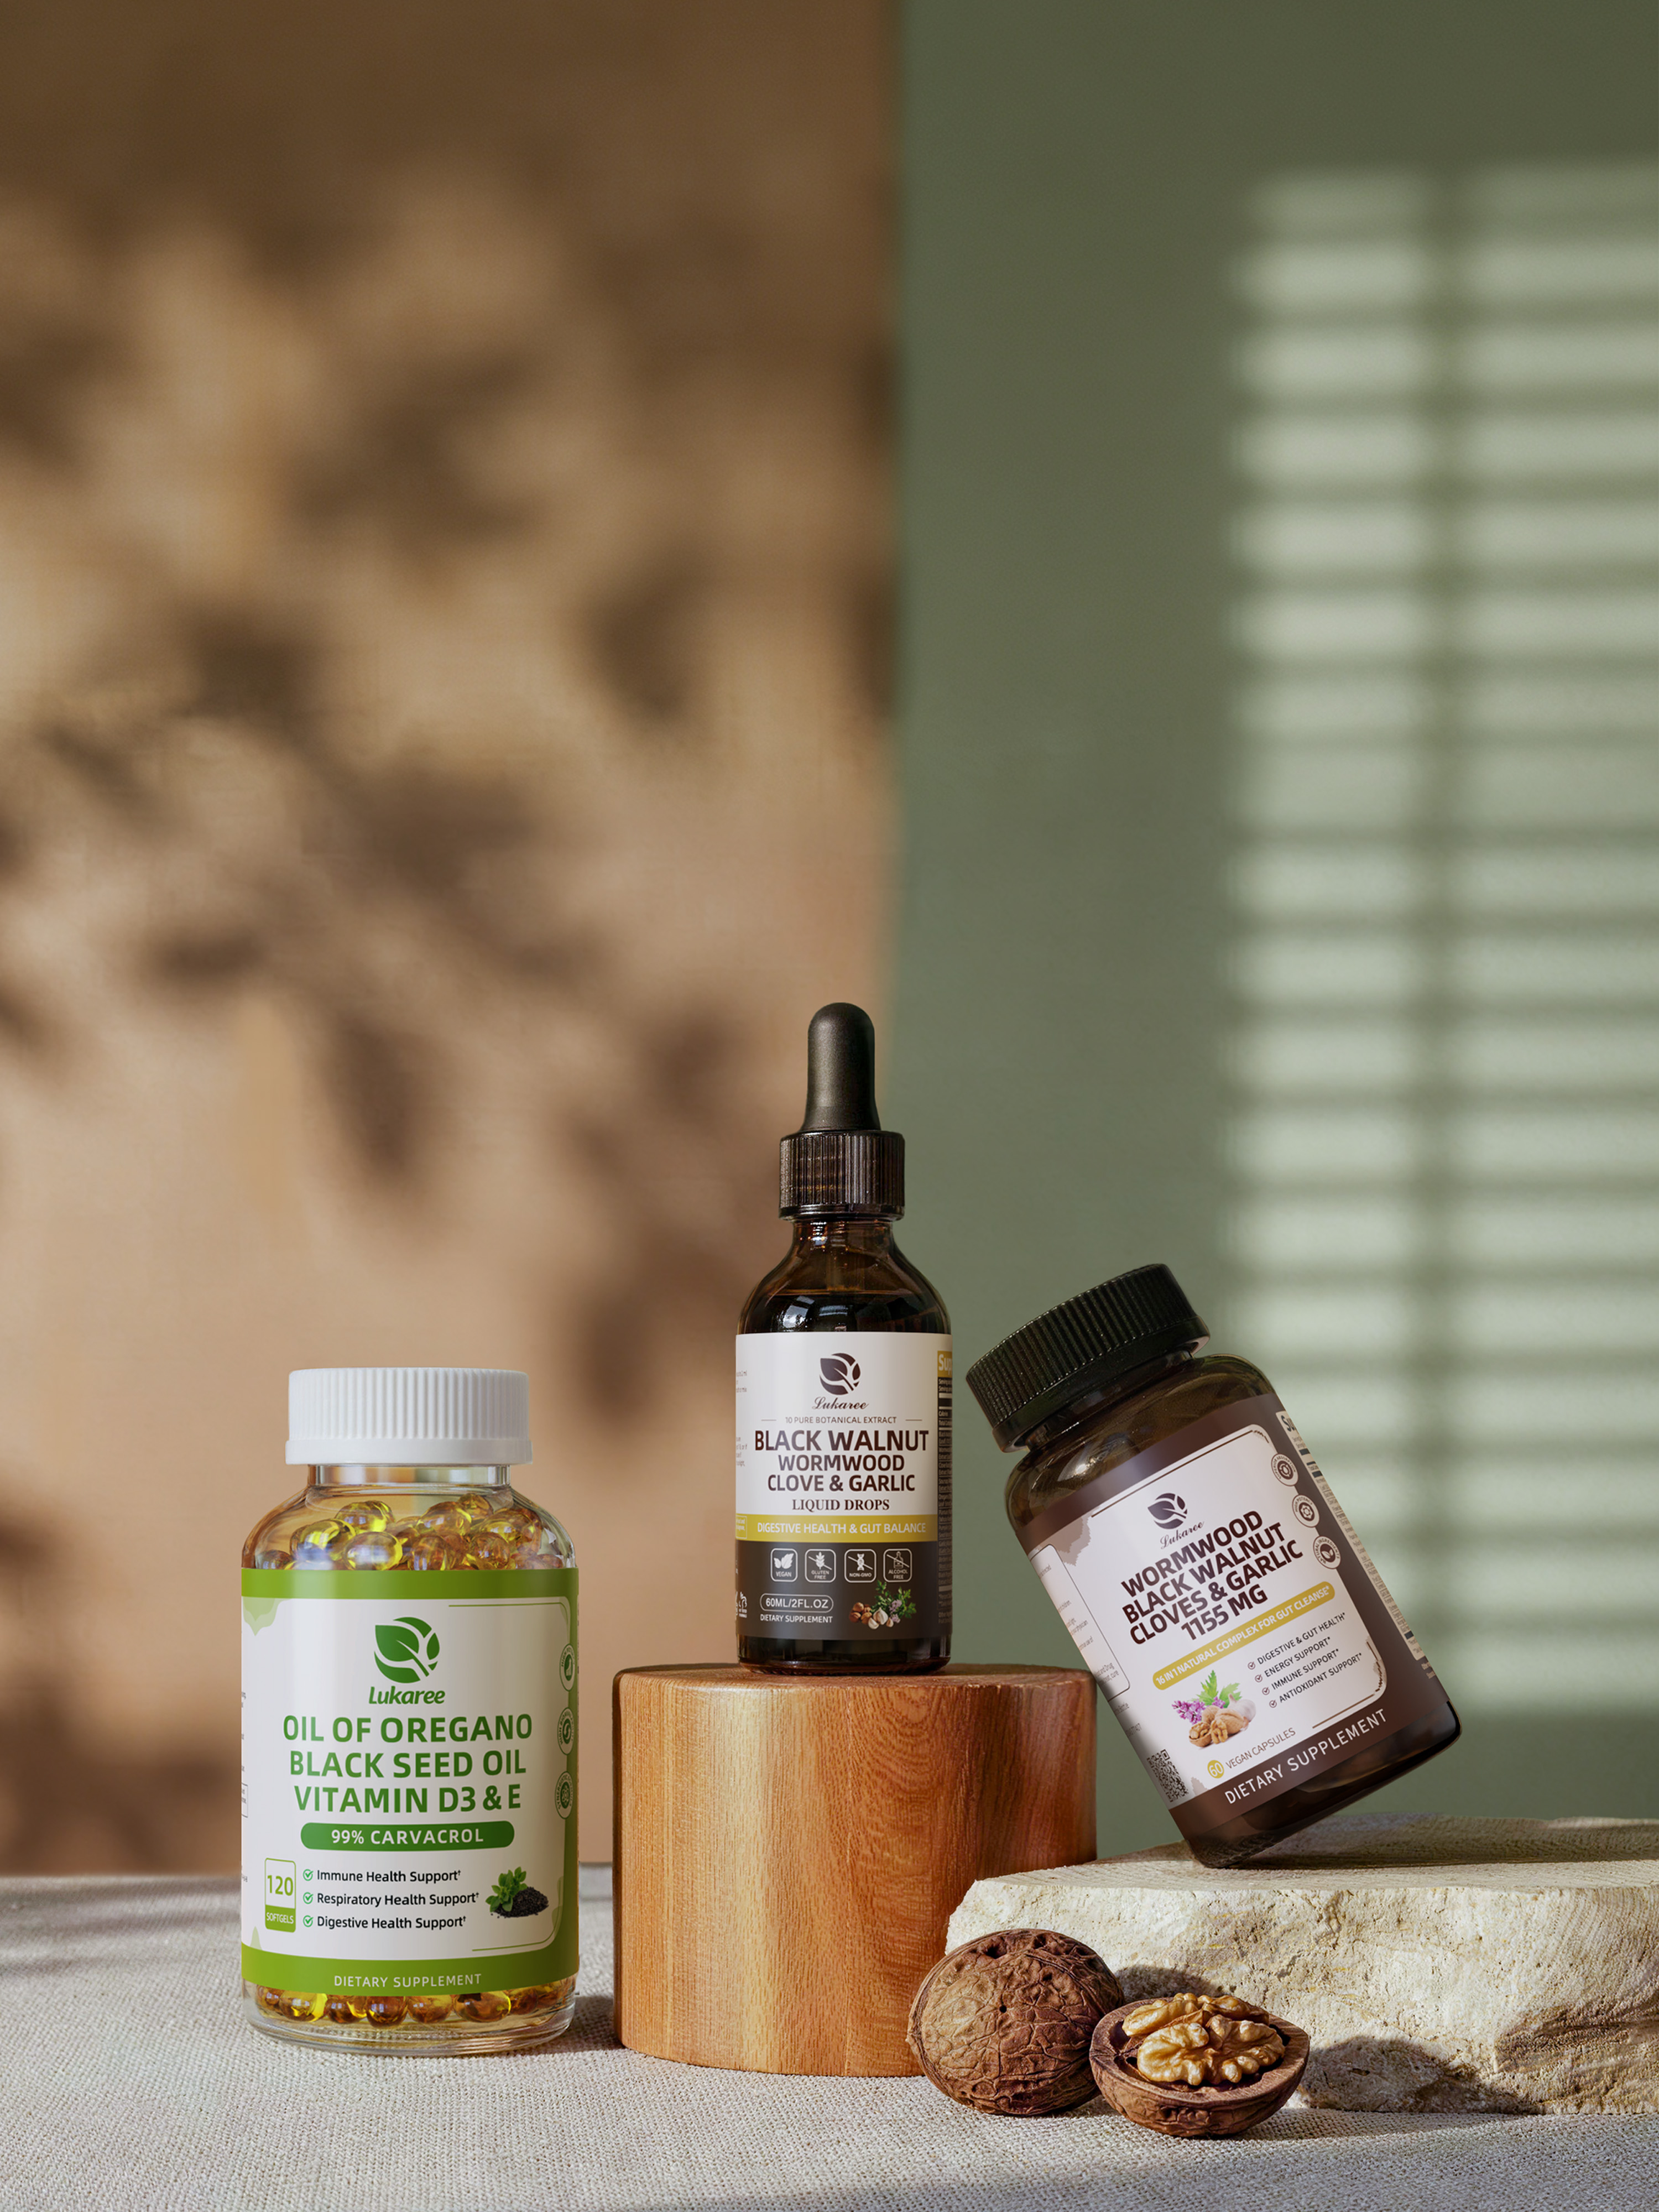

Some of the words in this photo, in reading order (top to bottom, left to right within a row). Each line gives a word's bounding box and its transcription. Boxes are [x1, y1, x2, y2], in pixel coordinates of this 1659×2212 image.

[812, 1396, 869, 1410] Lukaree
[755, 1430, 822, 1451] BLACK
[828, 1430, 928, 1451] WALNUT
[778, 1454, 905, 1471] WORMWOOD
[768, 1474, 823, 1491] CLOVE
[829, 1475, 843, 1491] &
[849, 1474, 915, 1491] GARLIC
[792, 1499, 840, 1512] LIQUID
[844, 1499, 890, 1510] DROPS
[757, 1523, 801, 1533] DIGESTIVE
[804, 1524, 847, 1533] HEALTH
[849, 1524, 858, 1533] &
[859, 1524, 882, 1533] GUT
[884, 1523, 926, 1533] BALANCE
[1160, 1521, 1204, 1549] Lukaree
[1121, 1511, 1263, 1598] WORMWOOD
[1122, 1573, 1193, 1624] BLACK
[1189, 1522, 1285, 1585] WALNUT
[1130, 1590, 1208, 1645] CLOVES
[1208, 1582, 1228, 1601] &
[1225, 1540, 1303, 1591] GARLIC
[765, 1598, 829, 1609] 60ML/2FL.OZ
[1181, 1604, 1229, 1640] 1155
[1227, 1584, 1268, 1617] MG
[760, 1614, 784, 1622] DIETARY
[785, 1615, 833, 1623] SUPPLEMENT
[1156, 1674, 1166, 1686] 16
[1164, 1670, 1175, 1682] IN
[1171, 1669, 1178, 1678] 1
[1176, 1648, 1217, 1673] NATURAL
[1216, 1624, 1260, 1653] COMPLEX
[1258, 1615, 1277, 1632] FOR
[1275, 1604, 1295, 1621] GUT
[1257, 1639, 1296, 1665] DIGESTIVE
[1296, 1636, 1302, 1645] &
[1302, 1627, 1318, 1640] GUT
[1264, 1657, 1294, 1677] ENERGY
[1271, 1669, 1303, 1690] IMMUNE
[1279, 1671, 1328, 1703] ANTIOXIDANT
[368, 1685, 446, 1704] Lukaree
[283, 1715, 324, 1741] OIL
[332, 1717, 371, 1743] OF
[380, 1714, 533, 1743] OREGANO
[1209, 1762, 1223, 1777] 60
[1225, 1750, 1253, 1769] VEGAN
[1251, 1728, 1296, 1755] CAPSULES
[1224, 1764, 1284, 1804] DIETARY
[1287, 1708, 1387, 1771] SUPPLEMENT
[290, 1750, 384, 1778] BLACK
[393, 1751, 473, 1778] SEED
[483, 1749, 526, 1776] OIL
[294, 1785, 427, 1813] VITAMIN
[440, 1786, 476, 1812] D3
[483, 1785, 502, 1810] &
[509, 1784, 521, 1809] E
[331, 1829, 364, 1844] 99%
[371, 1828, 484, 1845] CARVACROL
[267, 1875, 294, 1896] 120
[317, 1870, 363, 1881] Immune
[366, 1871, 406, 1882] Health
[317, 1893, 382, 1907] Respiratory
[385, 1893, 426, 1905] Health
[266, 1912, 294, 1924] SOFTGELS
[317, 1916, 368, 1929] Digestive
[372, 1917, 412, 1928] Health
[334, 1975, 388, 1987] DIETARY
[393, 1973, 482, 1987] SUPPLEMENT
